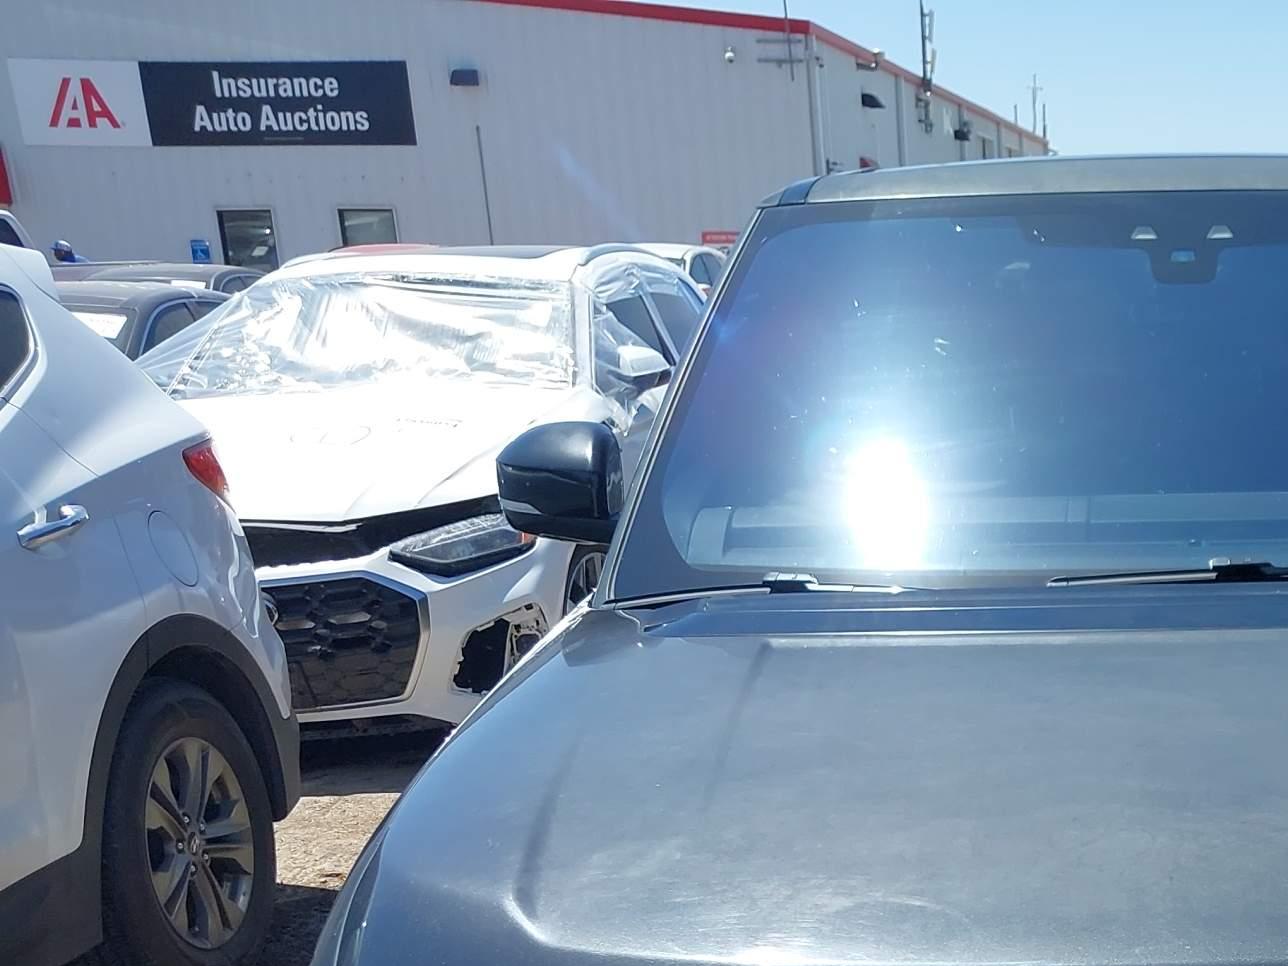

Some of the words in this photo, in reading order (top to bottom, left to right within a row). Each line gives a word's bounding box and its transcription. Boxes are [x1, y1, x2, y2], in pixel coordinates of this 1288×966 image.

[211, 70, 340, 98] Insurance
[193, 105, 252, 132] Auto
[259, 105, 371, 132] Auctions
